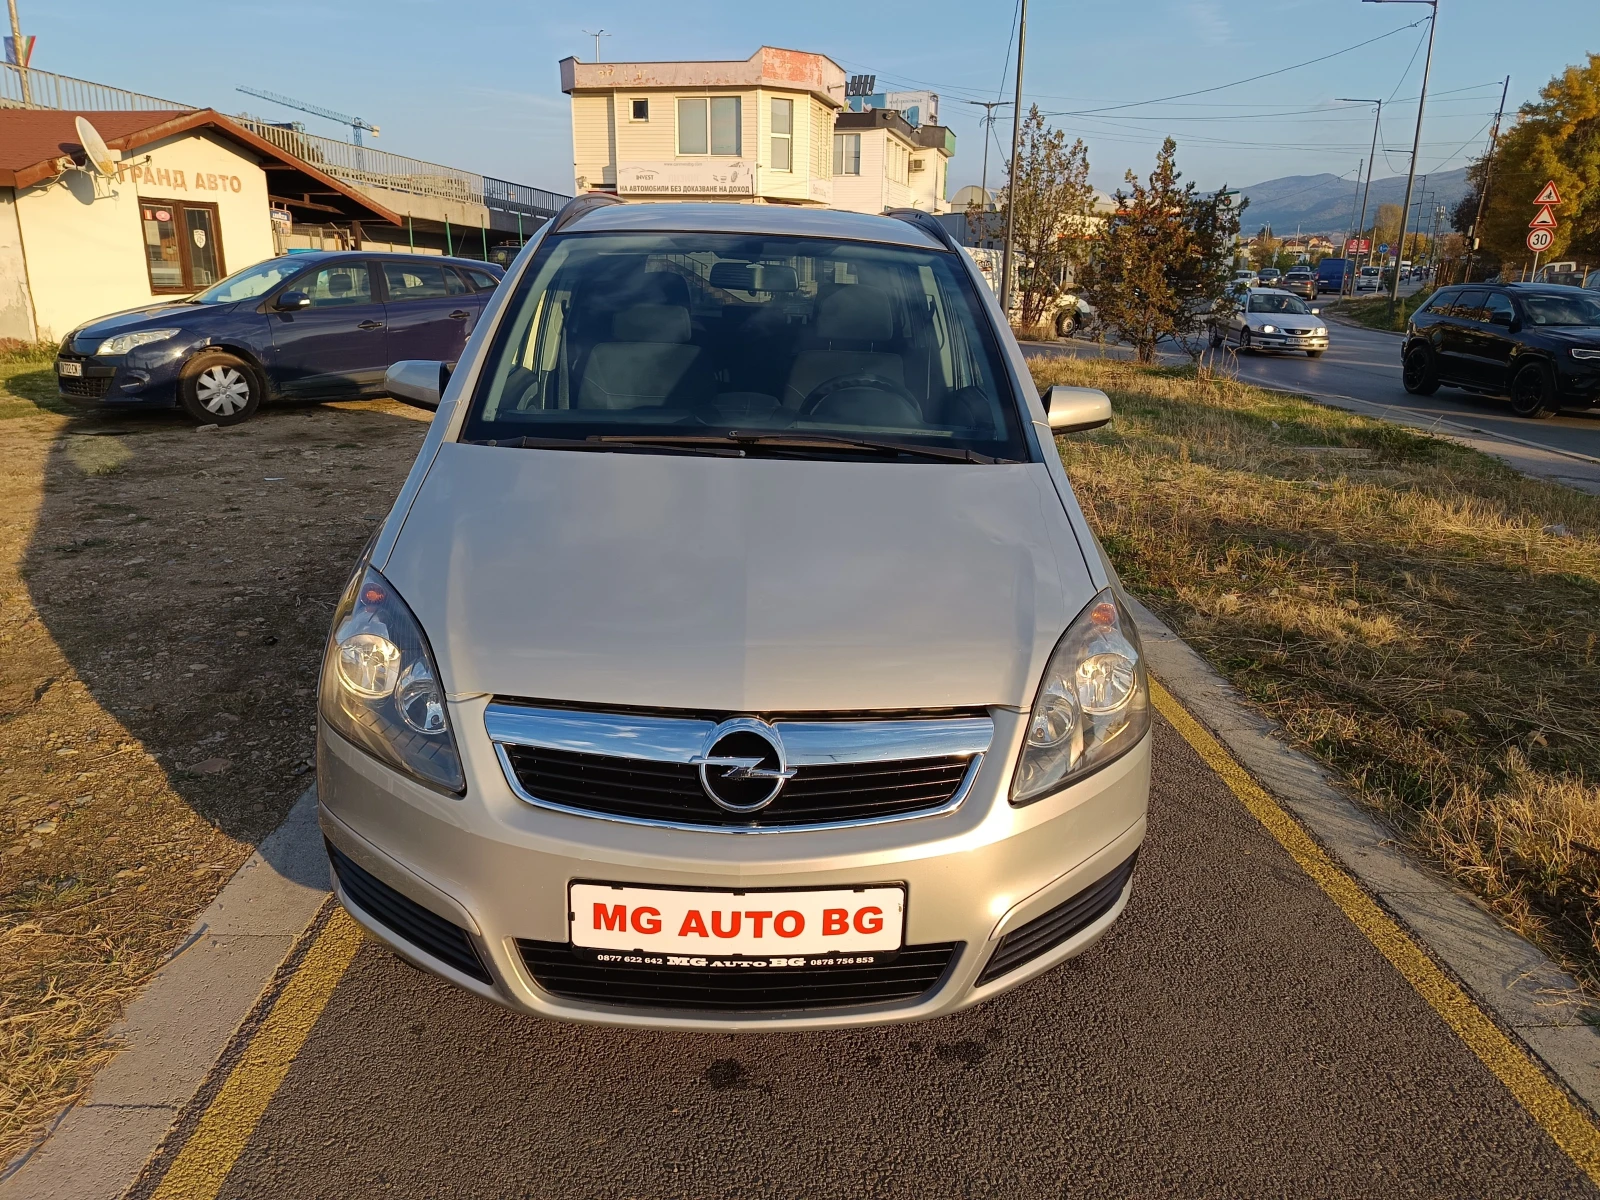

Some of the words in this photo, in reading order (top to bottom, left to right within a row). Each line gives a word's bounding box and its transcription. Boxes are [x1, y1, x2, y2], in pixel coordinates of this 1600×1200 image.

[117, 163, 188, 191] ГРАНД
[195, 172, 241, 193] АВТО
[728, 186, 750, 194] ДОХОД
[1532, 233, 1548, 246] 30
[593, 903, 662, 935] MG
[678, 909, 805, 939] AUTO
[822, 906, 884, 936] BG
[597, 954, 622, 962] 0877
[644, 957, 663, 965] 642
[667, 956, 708, 967] MG
[709, 960, 767, 968] AUTO
[768, 958, 806, 967] BG
[836, 957, 855, 965] 756
[856, 956, 875, 964] 853
